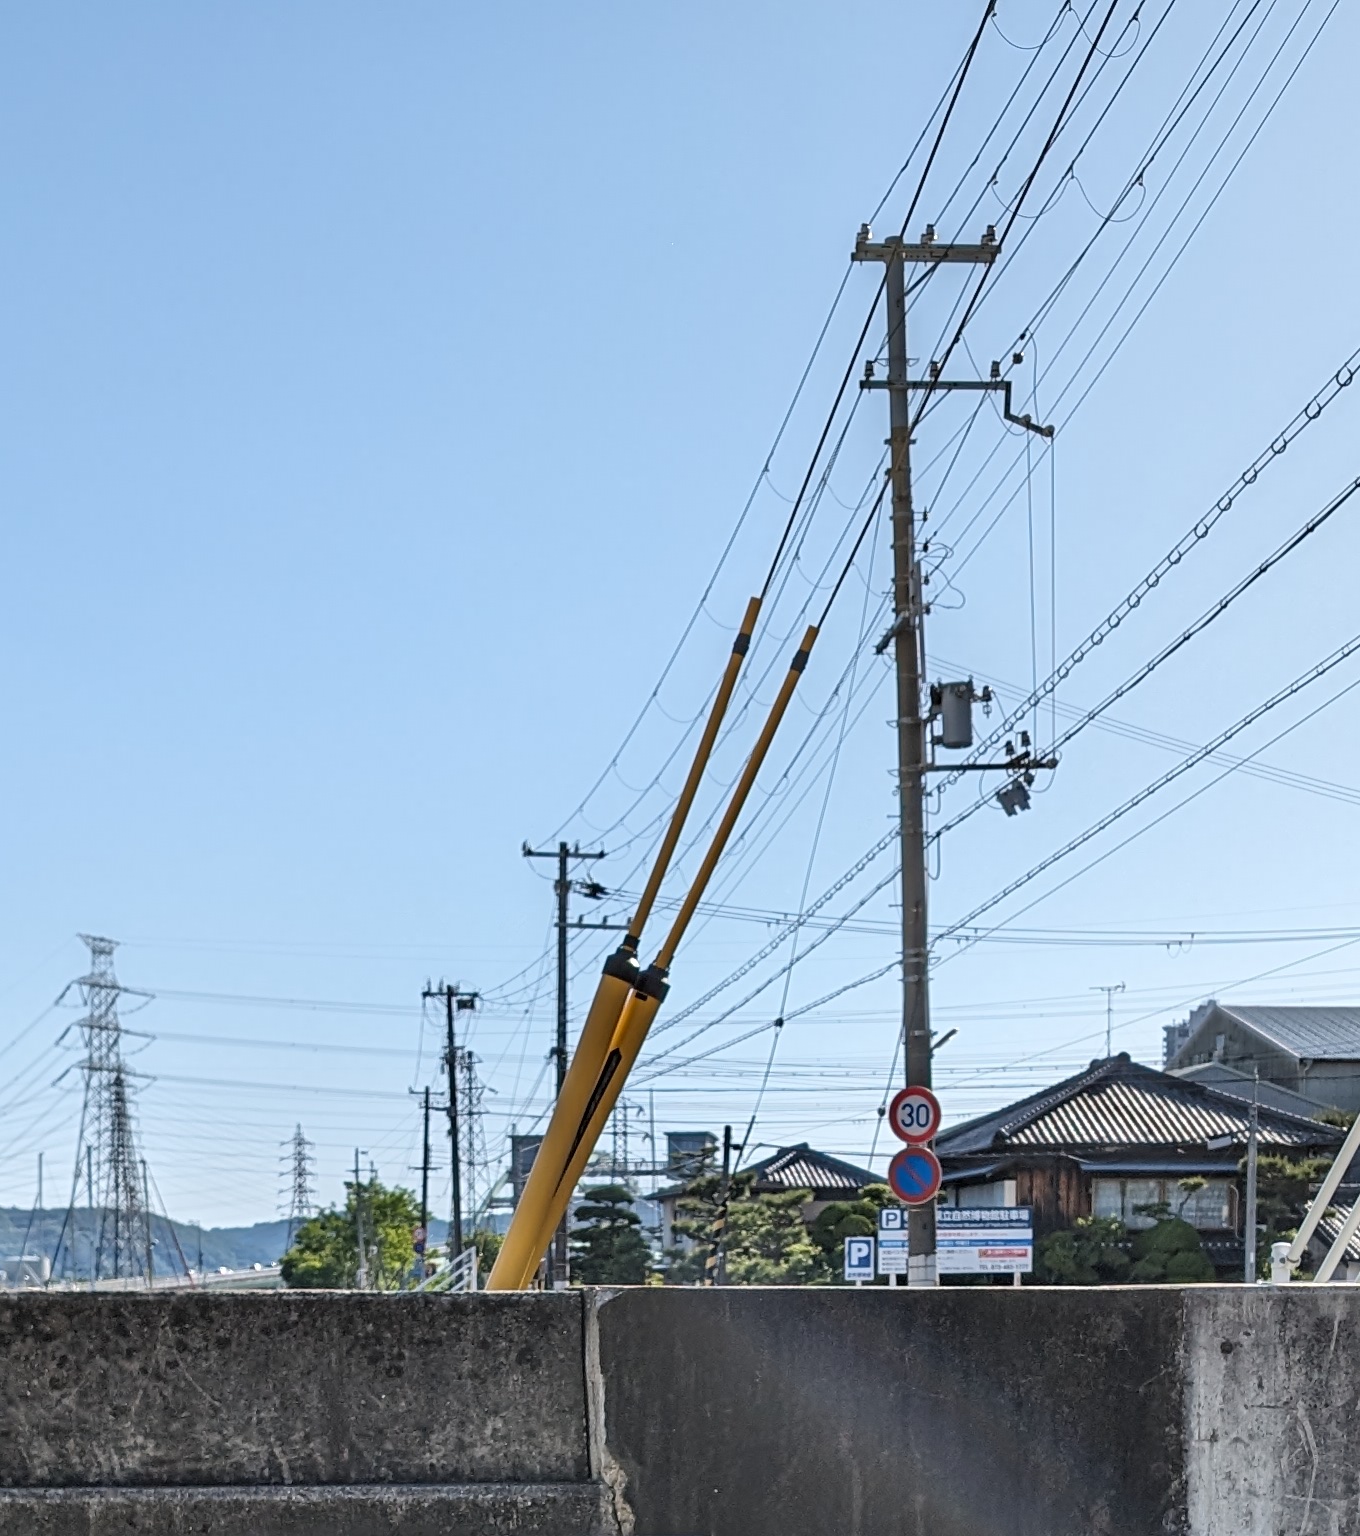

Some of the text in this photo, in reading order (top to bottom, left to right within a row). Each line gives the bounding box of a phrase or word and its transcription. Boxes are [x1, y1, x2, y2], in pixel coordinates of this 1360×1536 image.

[901, 1103, 930, 1128] 30
[886, 1212, 898, 1227] P
[850, 1243, 869, 1266] P
